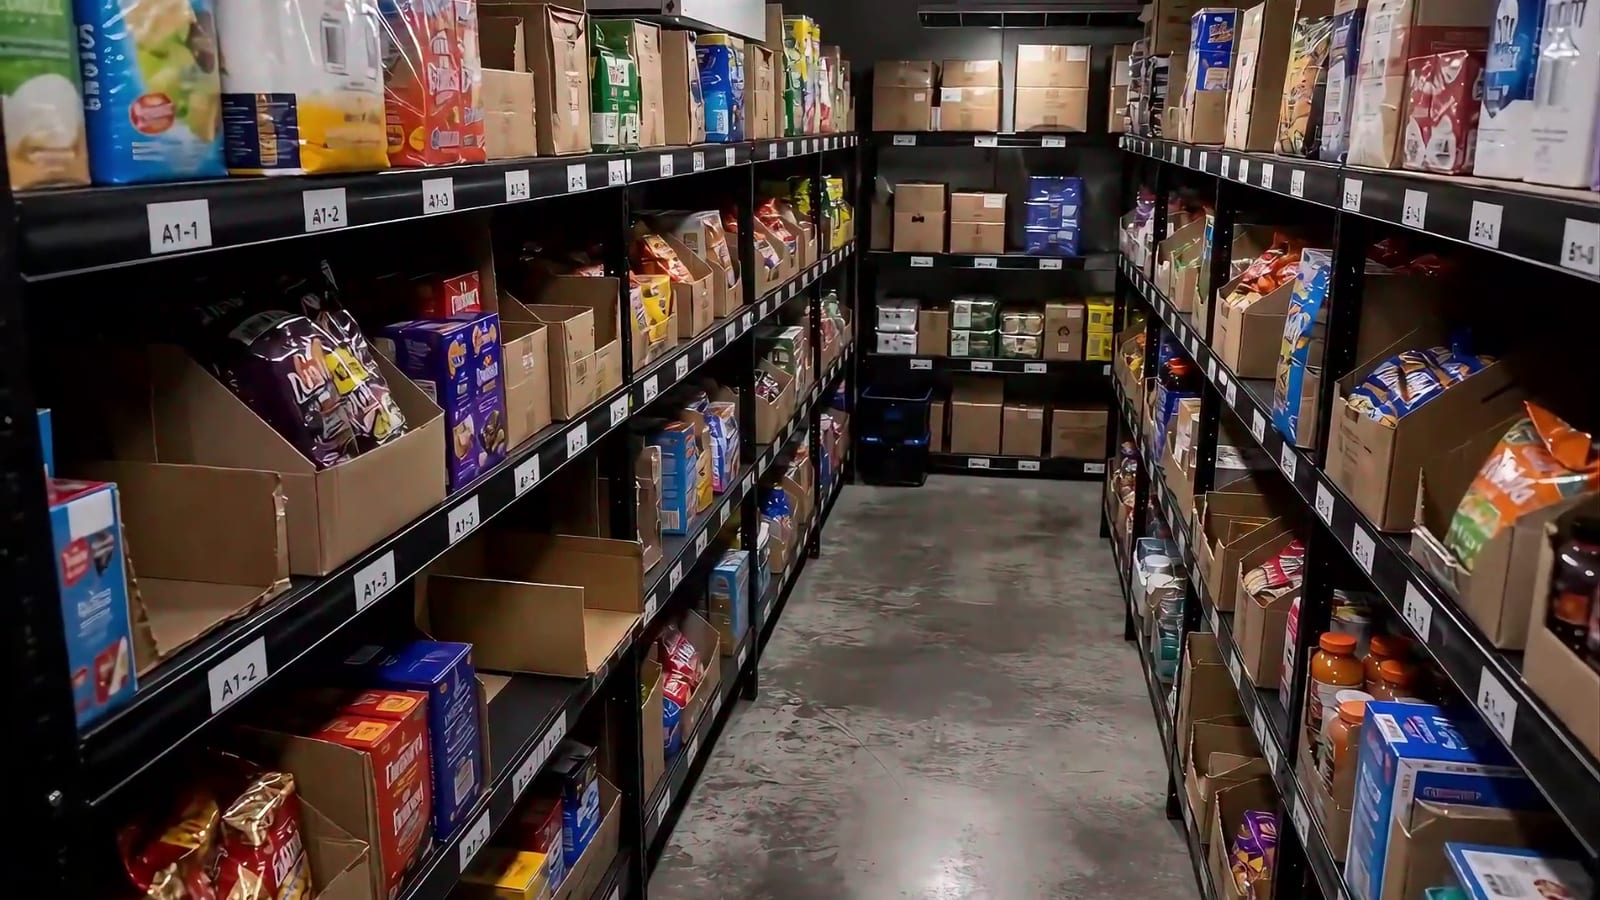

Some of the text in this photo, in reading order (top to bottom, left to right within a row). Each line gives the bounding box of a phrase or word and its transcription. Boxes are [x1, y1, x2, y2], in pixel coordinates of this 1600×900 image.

[313, 206, 339, 226] A1-2
[163, 222, 197, 244] A1-1
[364, 572, 387, 601] A1-3
[222, 663, 257, 700] A1-2
